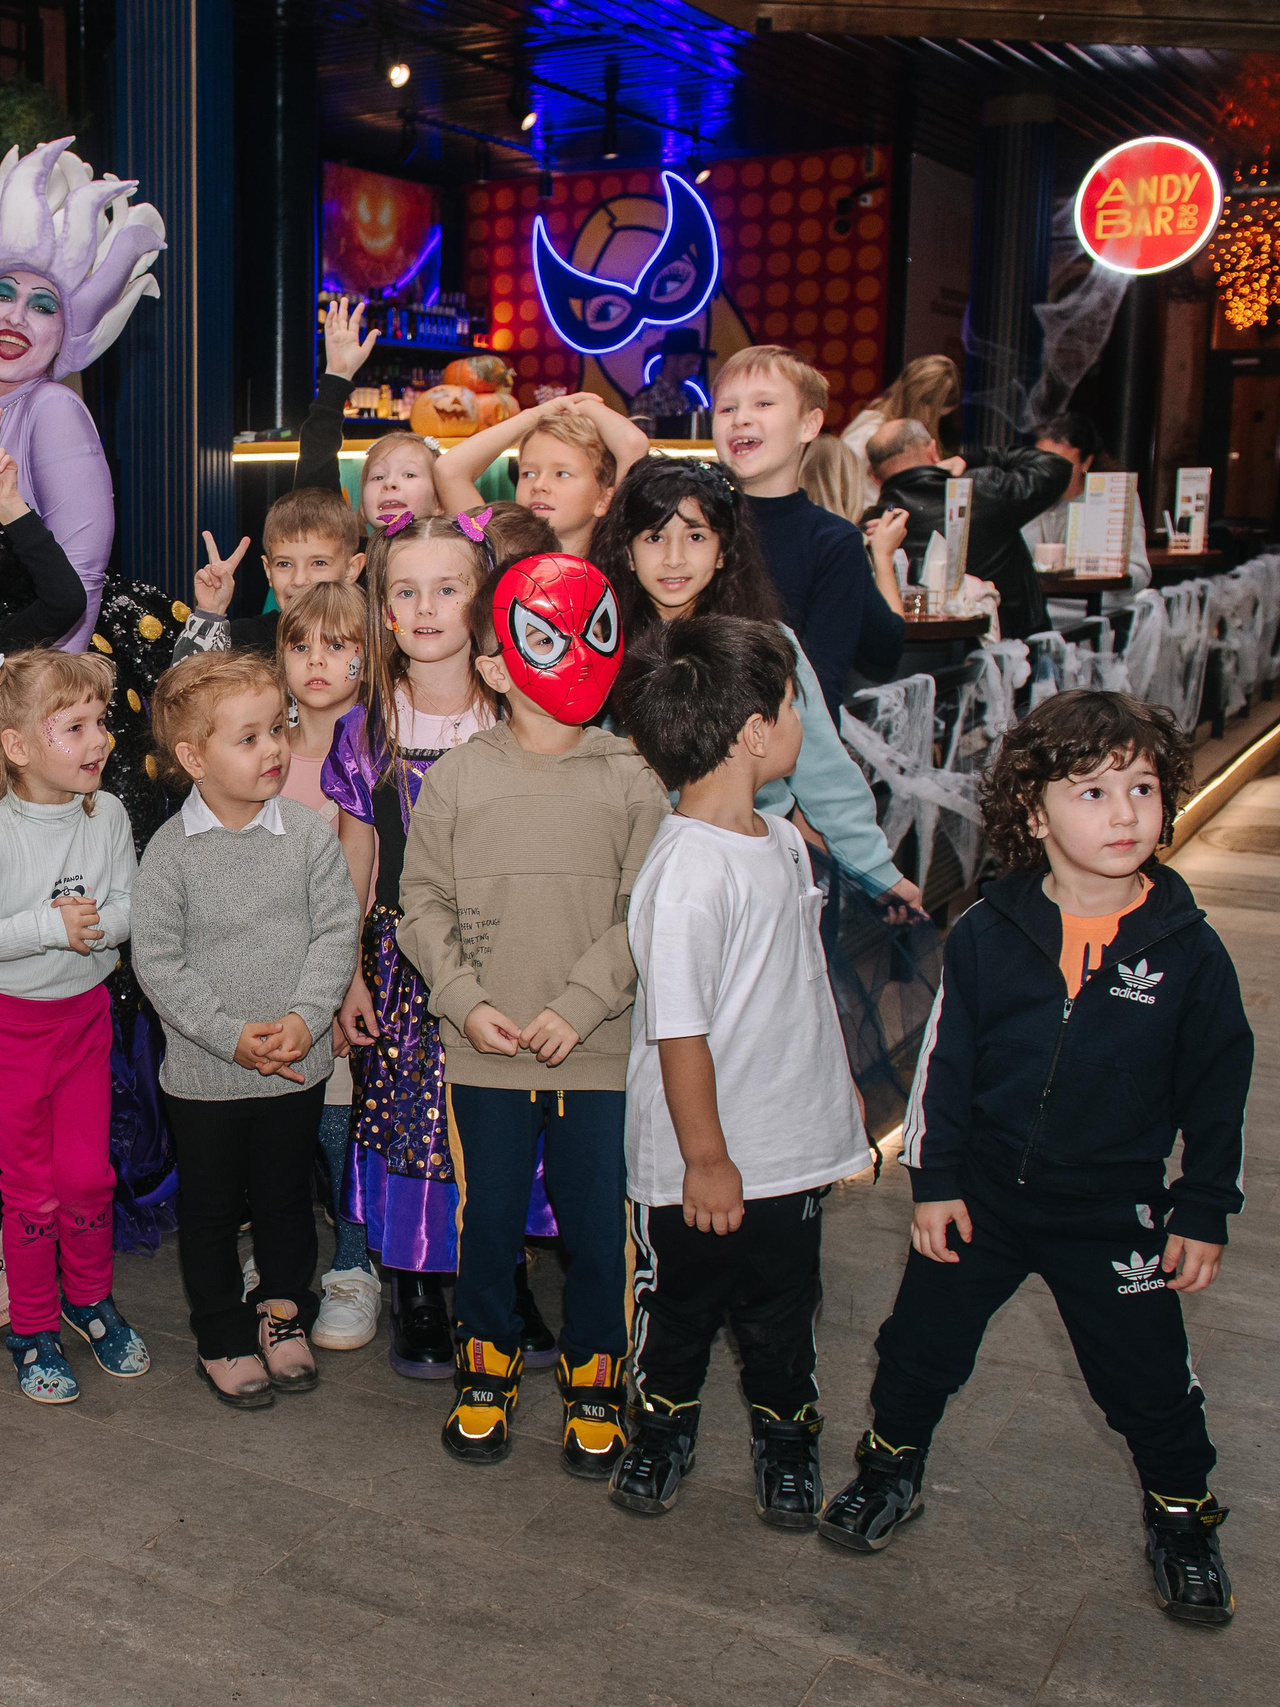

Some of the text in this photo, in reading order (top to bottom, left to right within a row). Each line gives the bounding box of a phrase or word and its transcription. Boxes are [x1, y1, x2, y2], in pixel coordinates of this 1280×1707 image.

[1095, 172, 1201, 210] ANDY
[1095, 206, 1175, 240] BAR
[1109, 985, 1156, 1005] adidas
[1117, 1278, 1166, 1294] adidas
[473, 1390, 494, 1402] KKD
[583, 1404, 605, 1417] KKD
